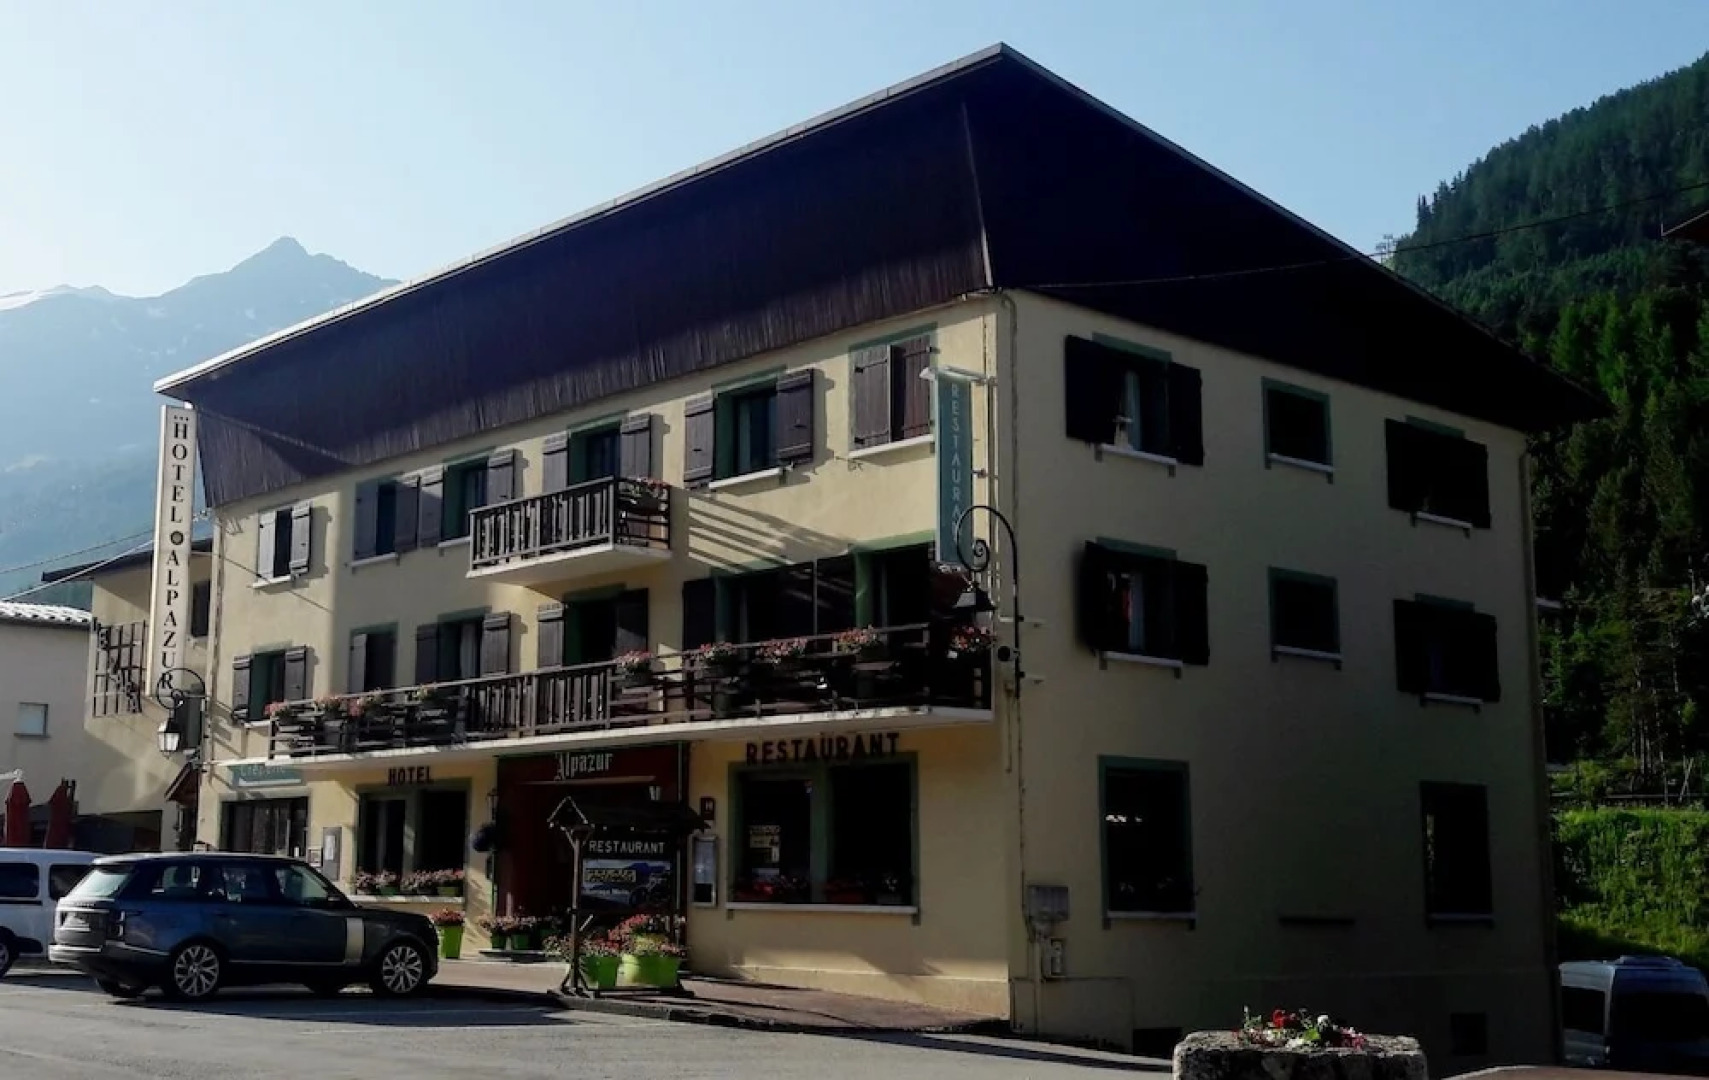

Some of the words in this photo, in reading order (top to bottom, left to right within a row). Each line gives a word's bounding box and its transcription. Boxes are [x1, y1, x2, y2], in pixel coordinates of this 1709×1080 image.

[170, 423, 188, 524] HOTEL
[951, 383, 961, 545] RESTAURAN
[161, 549, 180, 689] ALPAZUR
[746, 732, 900, 765] RESTAURANT
[387, 766, 434, 787] HOTEL
[554, 752, 613, 780] Alpazur
[589, 840, 665, 854] RESTAURANT
